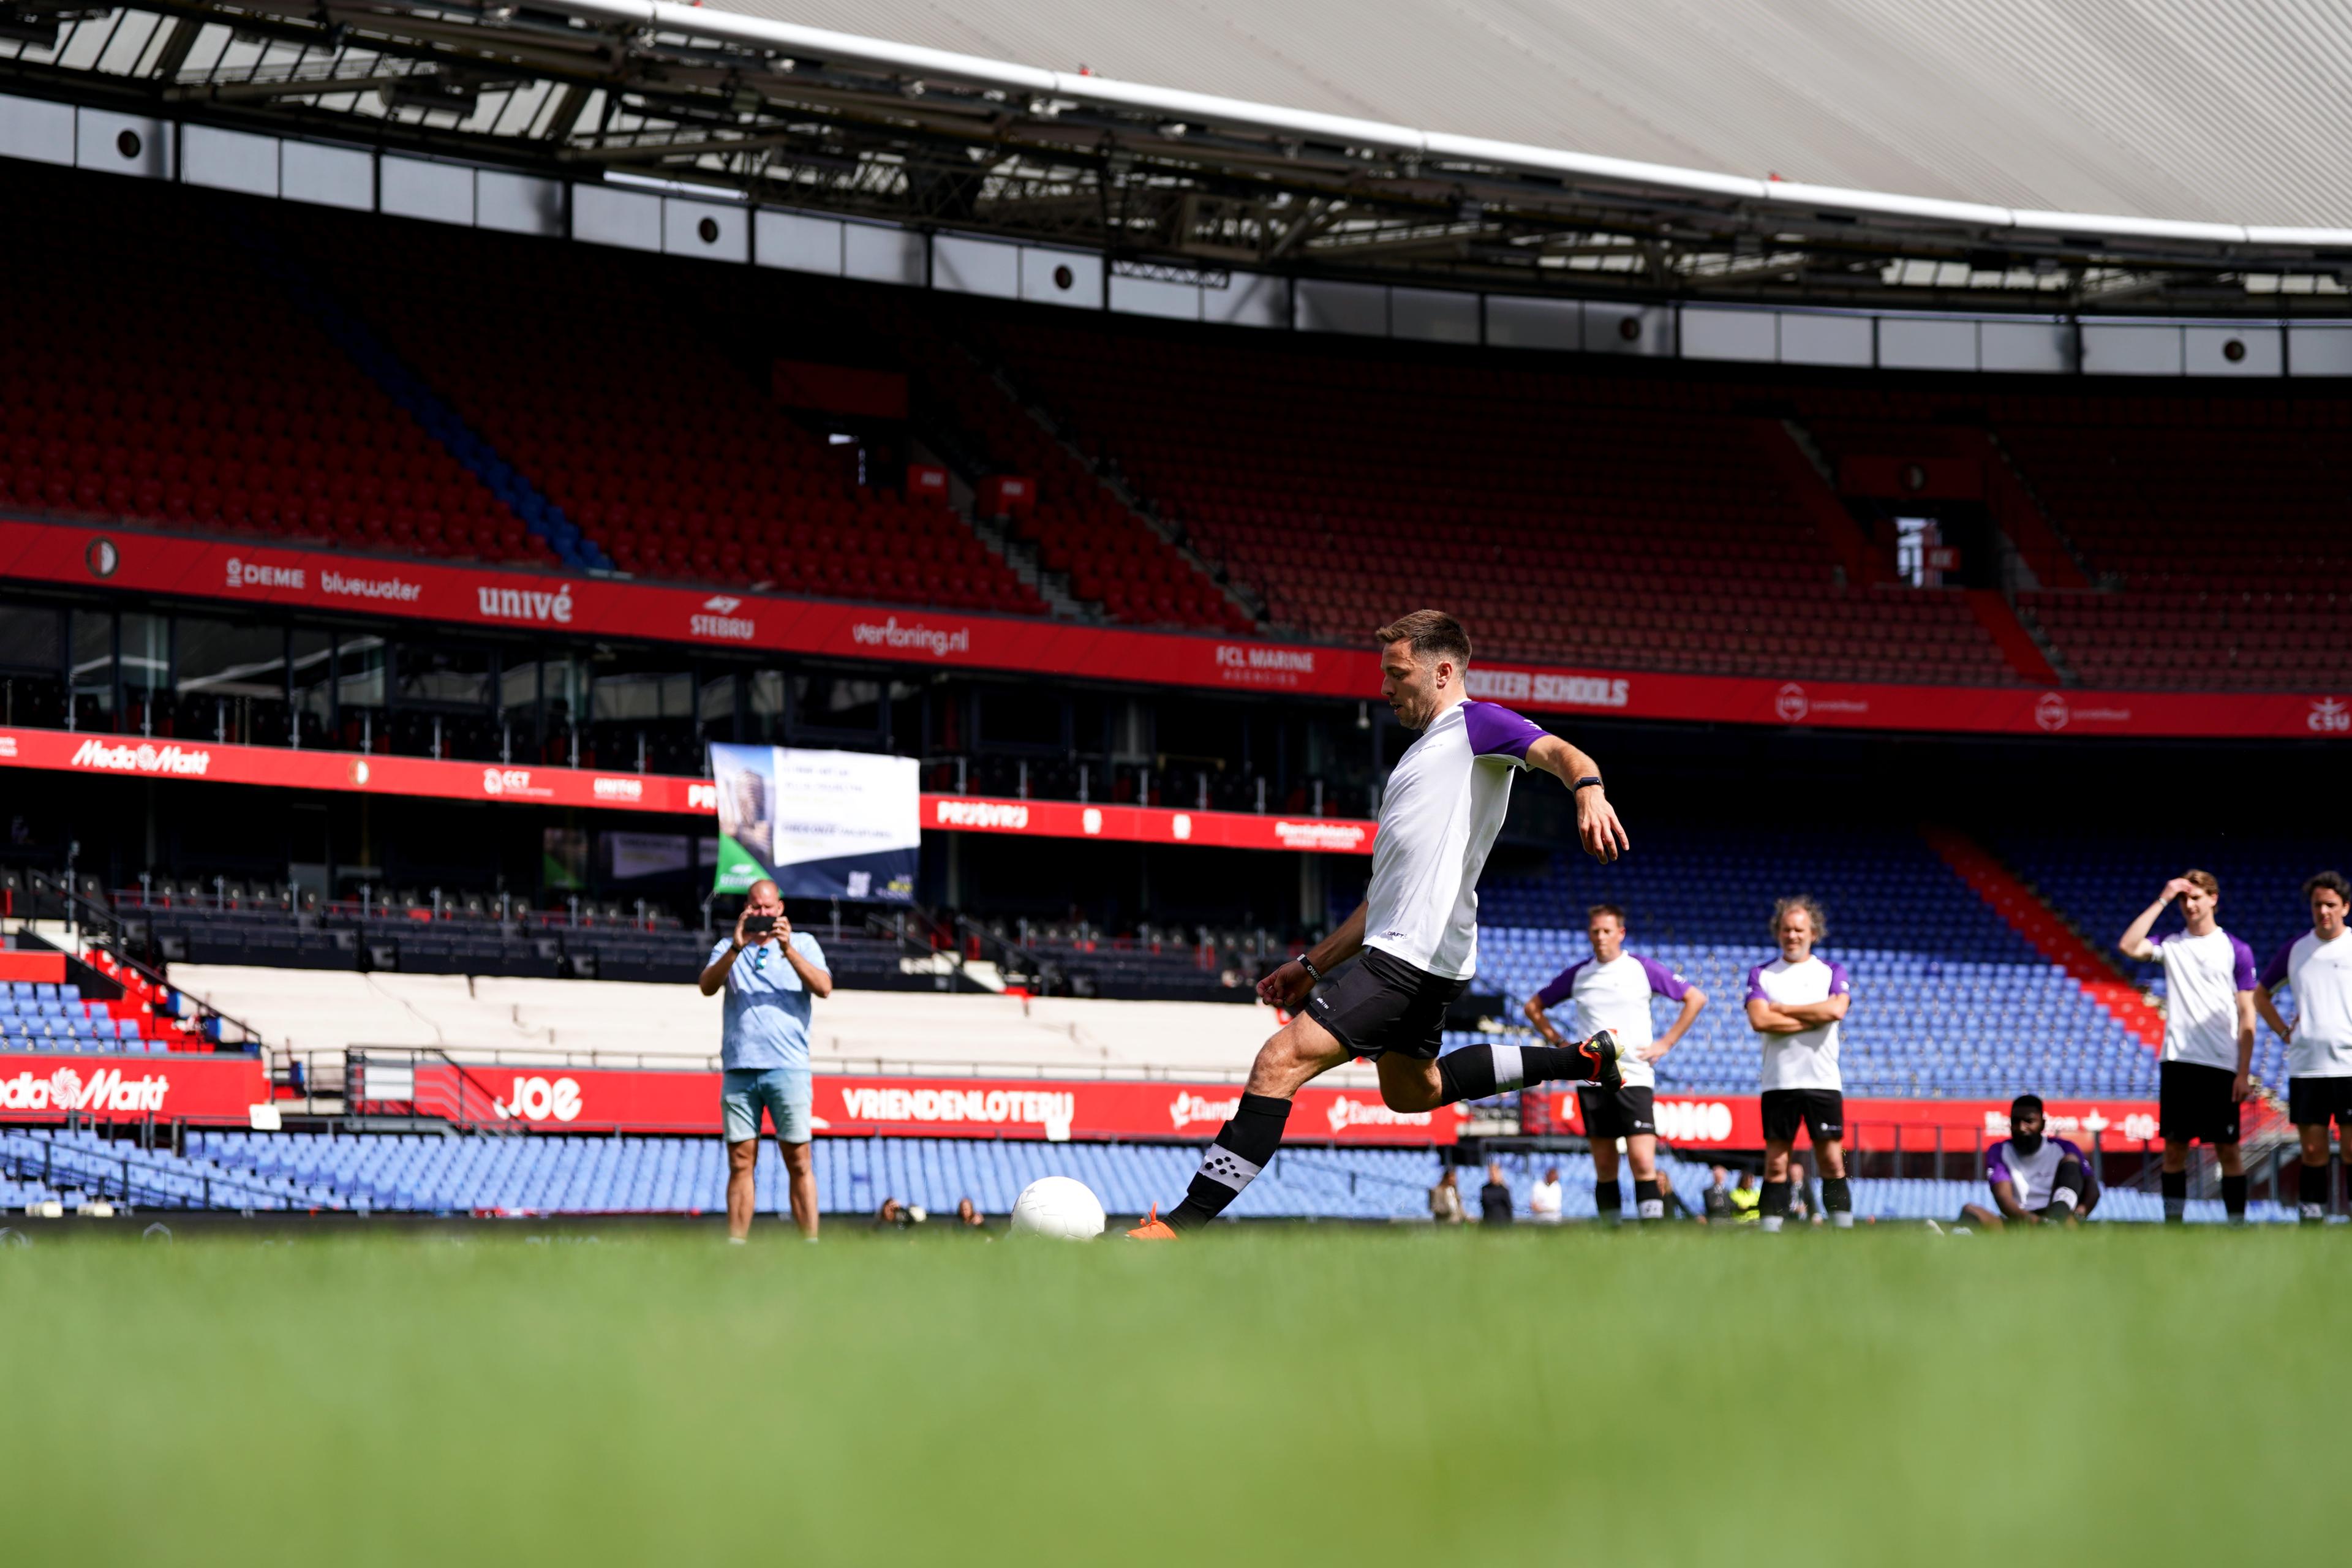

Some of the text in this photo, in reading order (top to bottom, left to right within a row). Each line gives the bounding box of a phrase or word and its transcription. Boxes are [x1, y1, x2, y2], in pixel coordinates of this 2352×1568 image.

[244, 564, 305, 589] DEME
[321, 570, 421, 601] bluewater
[477, 584, 573, 622] univé
[690, 614, 754, 639] STEBRU
[1216, 646, 1314, 673] FCL MARINE
[1532, 673, 1630, 707] SCHOOLS
[2307, 712, 2350, 731] CSU
